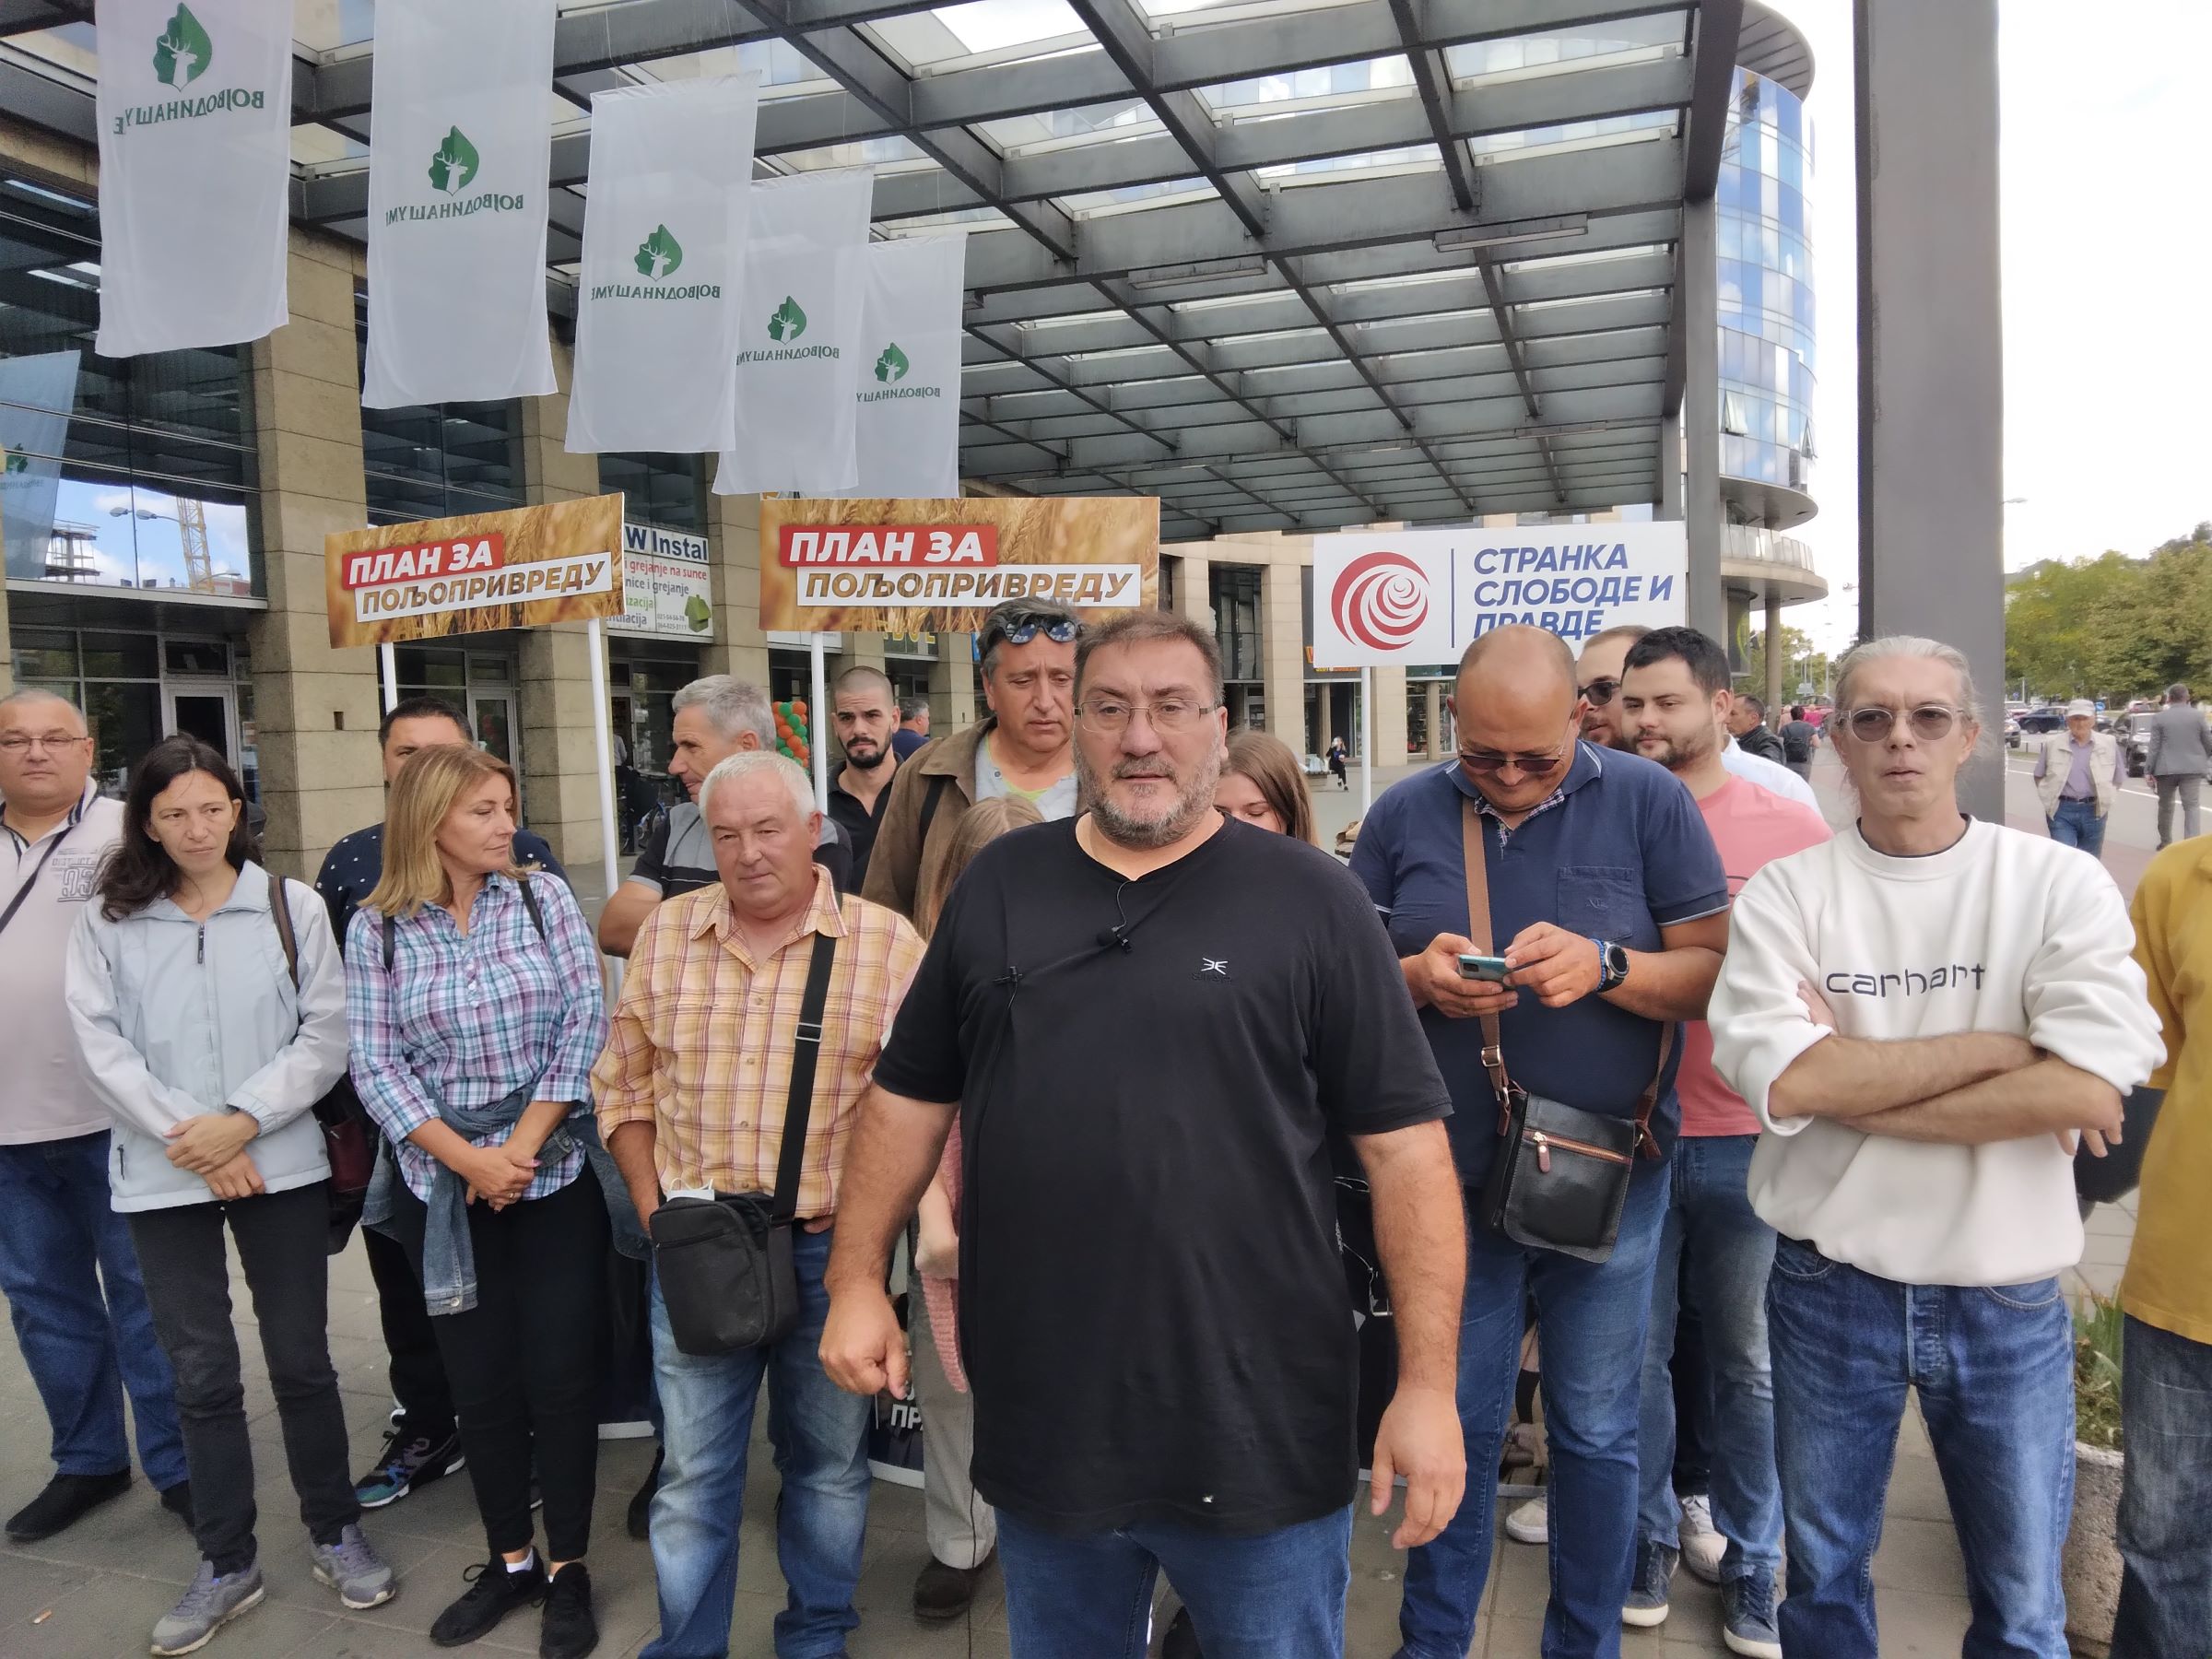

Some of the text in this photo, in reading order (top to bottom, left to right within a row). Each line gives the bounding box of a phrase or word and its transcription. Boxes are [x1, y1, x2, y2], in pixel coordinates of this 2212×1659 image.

[653, 531, 708, 560] Instal
[790, 532, 984, 562] ПЛАН ЗА
[1474, 544, 1629, 574] СТРАНКА
[348, 540, 493, 585] ПЛАН ЗА
[629, 560, 669, 578] grejanje
[670, 566, 680, 576] na
[683, 569, 707, 581] sunce
[362, 560, 605, 615] ПОЉОПРИВРЕДУ
[653, 582, 689, 597] grejanje
[806, 572, 1134, 603] ПОЉОПРИВРЕДУ
[1474, 575, 1673, 606] СЛОБОДЕ И
[1826, 963, 1985, 997] carhart
[890, 1403, 924, 1430] ПР
